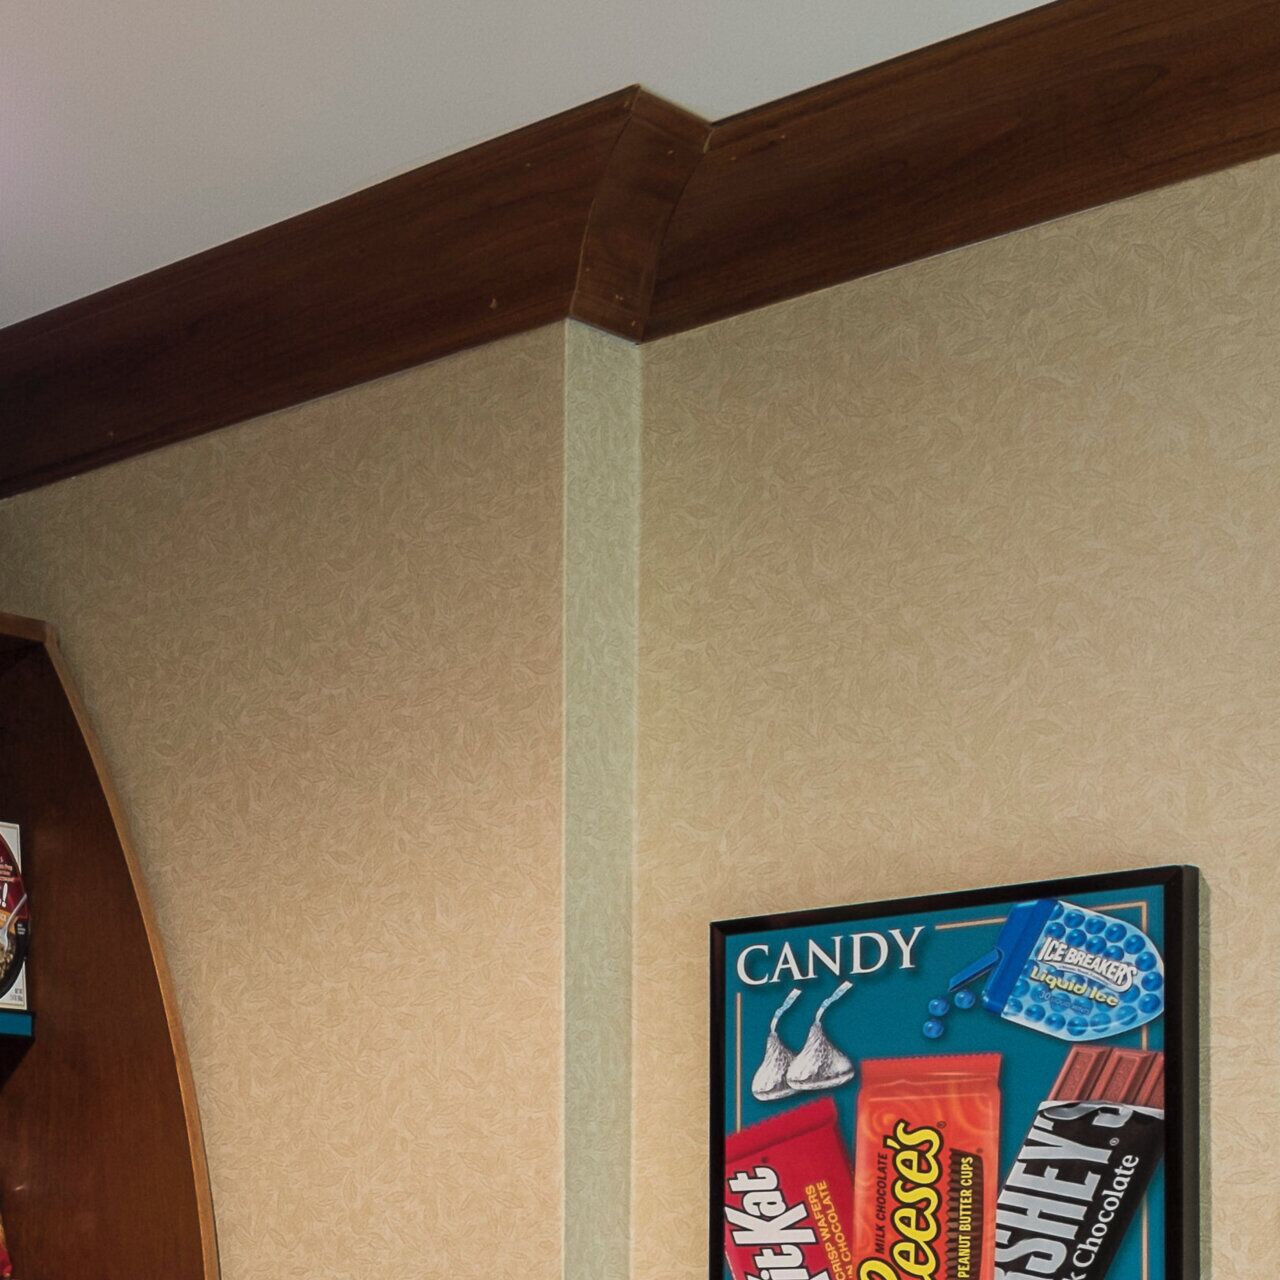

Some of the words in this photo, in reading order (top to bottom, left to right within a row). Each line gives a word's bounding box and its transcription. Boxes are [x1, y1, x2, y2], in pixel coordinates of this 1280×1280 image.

[736, 925, 926, 986] CANDY
[1038, 937, 1066, 964] ICE
[1063, 946, 1138, 988] BREAKERS
[1030, 964, 1087, 996] Liquid
[1088, 987, 1119, 1007] Ice
[876, 1151, 889, 1219] CHOCOLATE
[961, 1156, 973, 1188] CUPS
[960, 1190, 972, 1228] BUTTER
[875, 1222, 887, 1255] MILK
[959, 1228, 971, 1275] PEANUT
